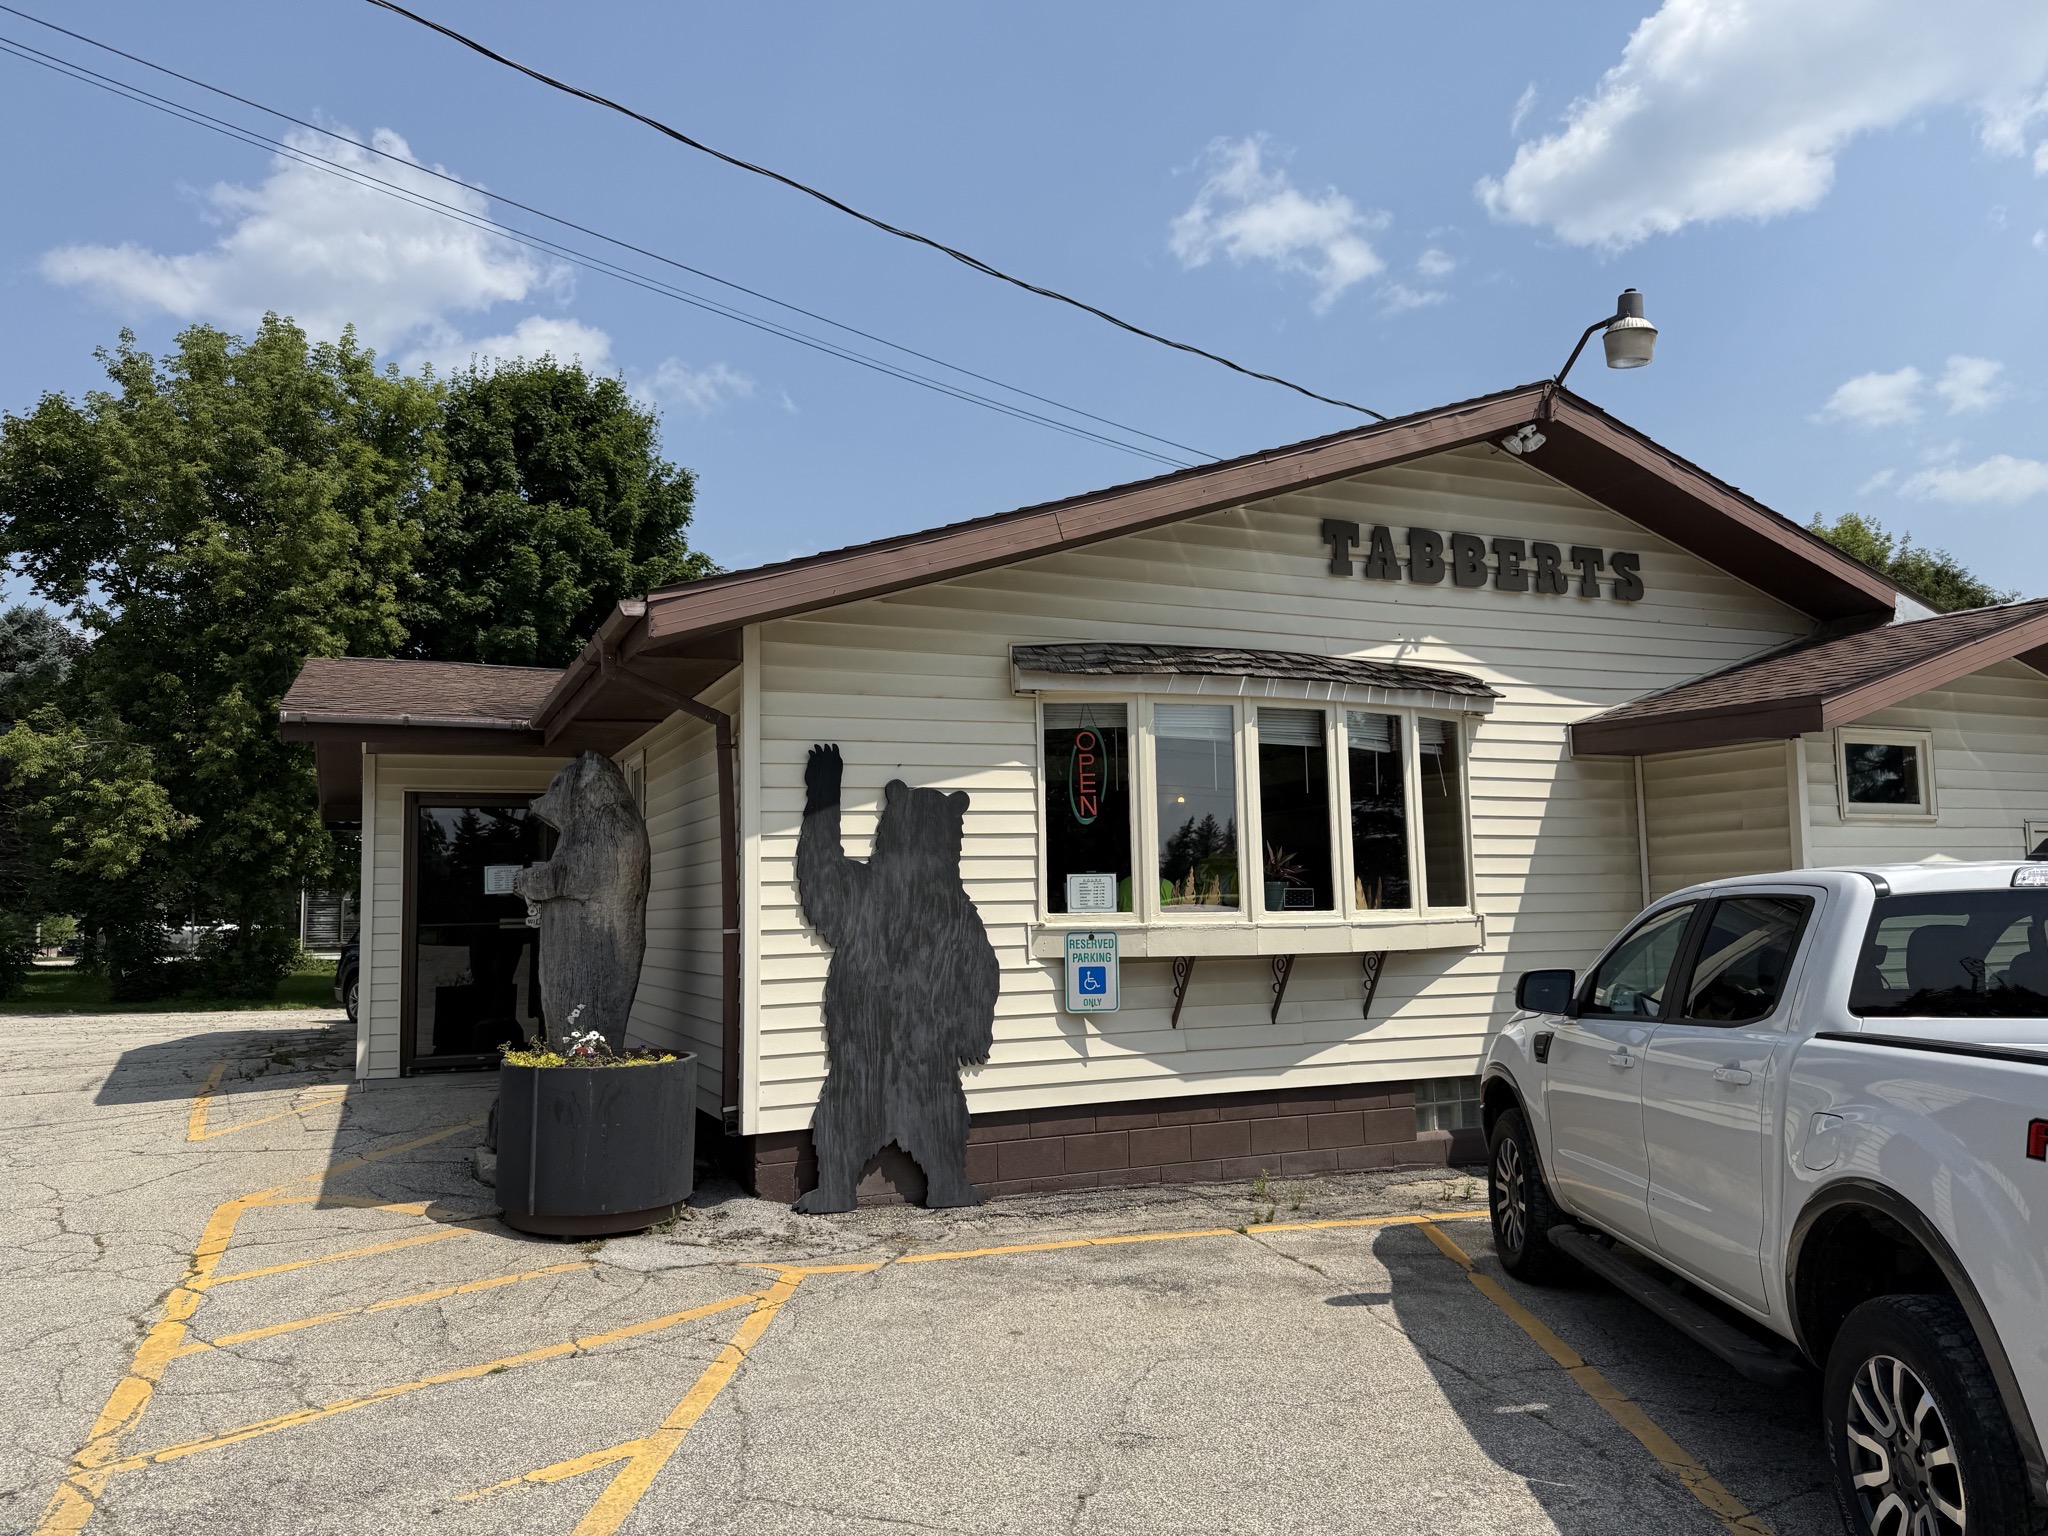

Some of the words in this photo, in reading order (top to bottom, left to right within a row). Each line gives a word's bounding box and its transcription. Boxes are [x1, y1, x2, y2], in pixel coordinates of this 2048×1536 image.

[1322, 518, 1645, 602] TABBERTS
[1075, 731, 1098, 817] OPEN
[1069, 938, 1115, 949] RESERVED
[1072, 952, 1112, 963] PARKING
[1083, 998, 1102, 1007] ONLY
